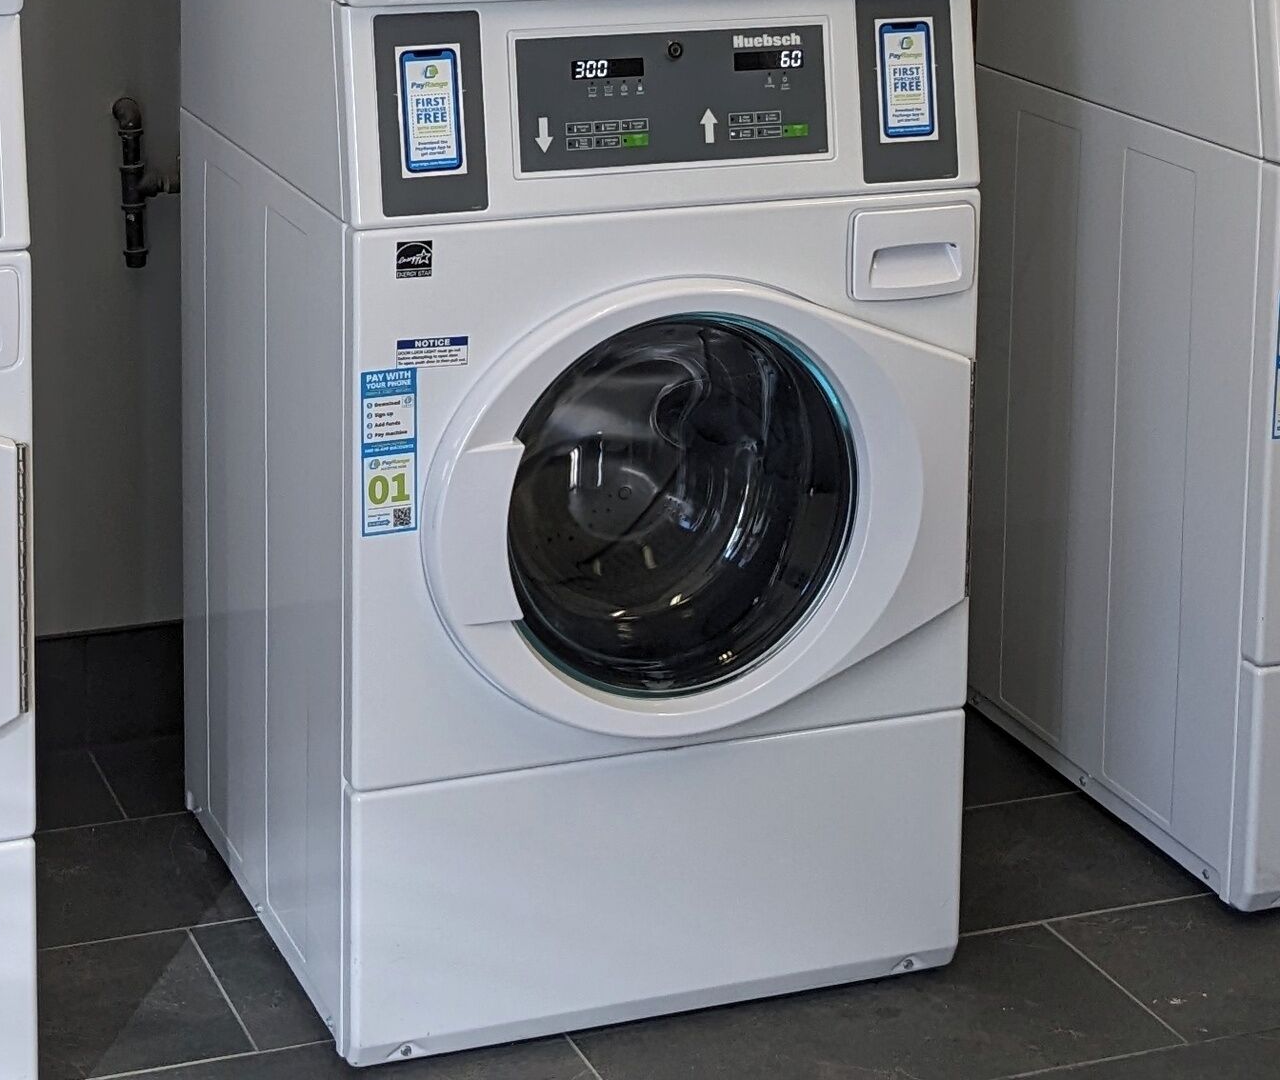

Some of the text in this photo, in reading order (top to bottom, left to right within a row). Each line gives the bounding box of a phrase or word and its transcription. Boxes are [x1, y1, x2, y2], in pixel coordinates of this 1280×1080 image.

[733, 33, 801, 48] Huebsch
[780, 51, 802, 68] 60
[575, 60, 608, 79] 300
[893, 67, 921, 77] FIRST
[411, 81, 448, 90] PayRange
[893, 81, 922, 92] FREE
[415, 97, 447, 108] FIRST
[416, 112, 448, 124] FREE
[418, 269, 432, 277] STAR
[414, 339, 451, 348] NOTICE
[366, 371, 411, 383] PAY WITH
[366, 379, 412, 390] YOUR PHONE
[368, 473, 410, 505] 01
